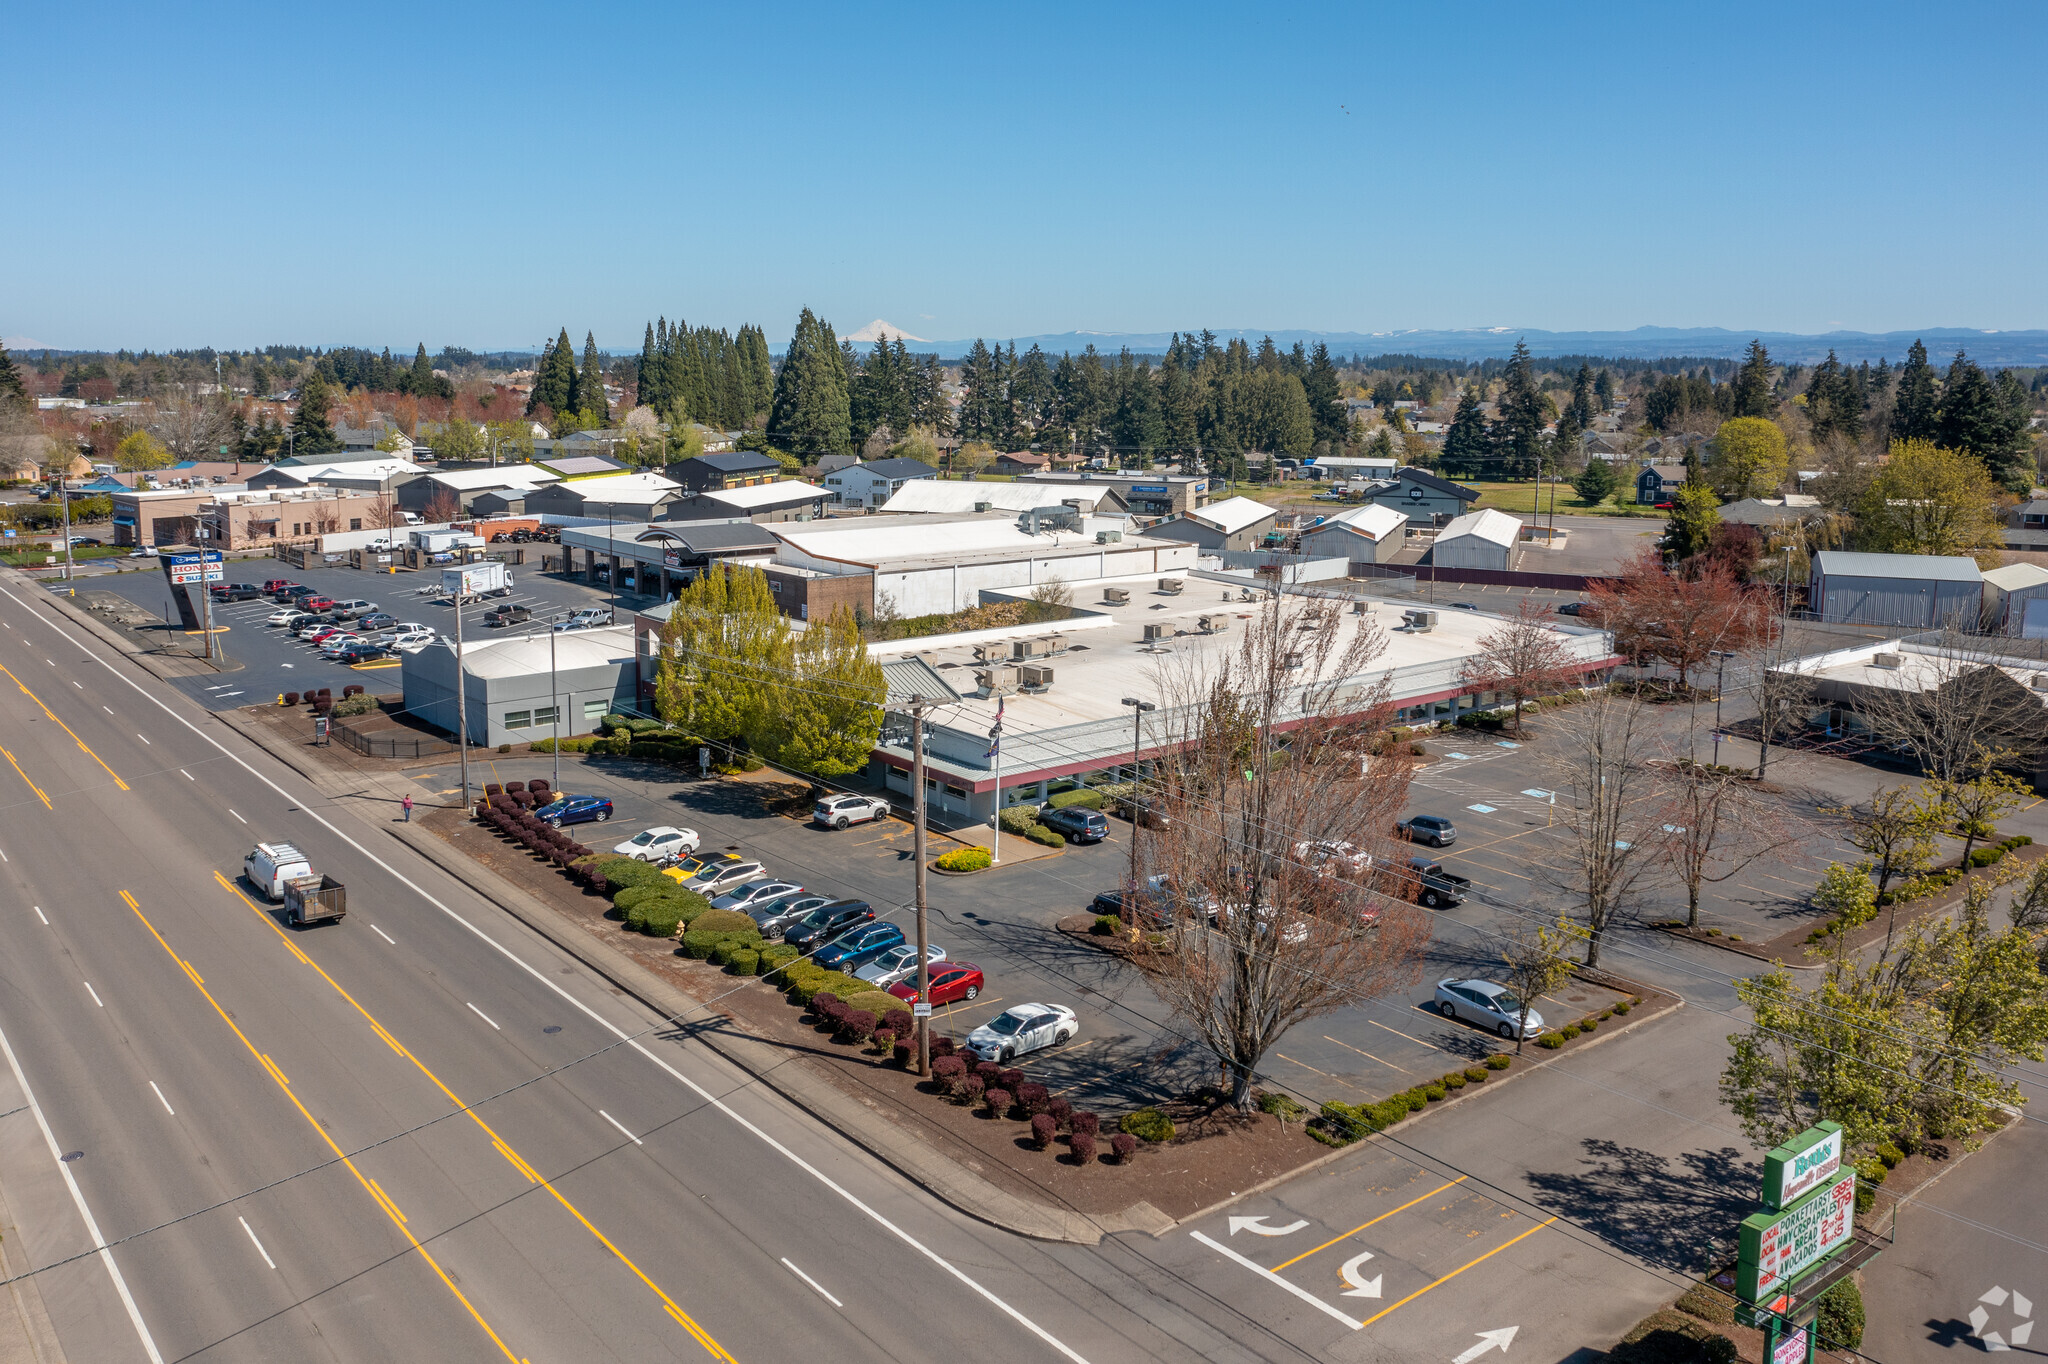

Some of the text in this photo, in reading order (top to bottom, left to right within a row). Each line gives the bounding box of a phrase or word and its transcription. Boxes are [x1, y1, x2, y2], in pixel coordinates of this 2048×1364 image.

[185, 554, 217, 562] POLRIS
[1762, 1225, 1779, 1244] LOCAL
[1794, 1227, 1818, 1252] BREAD
[1779, 1240, 1818, 1276] AVOCADOS
